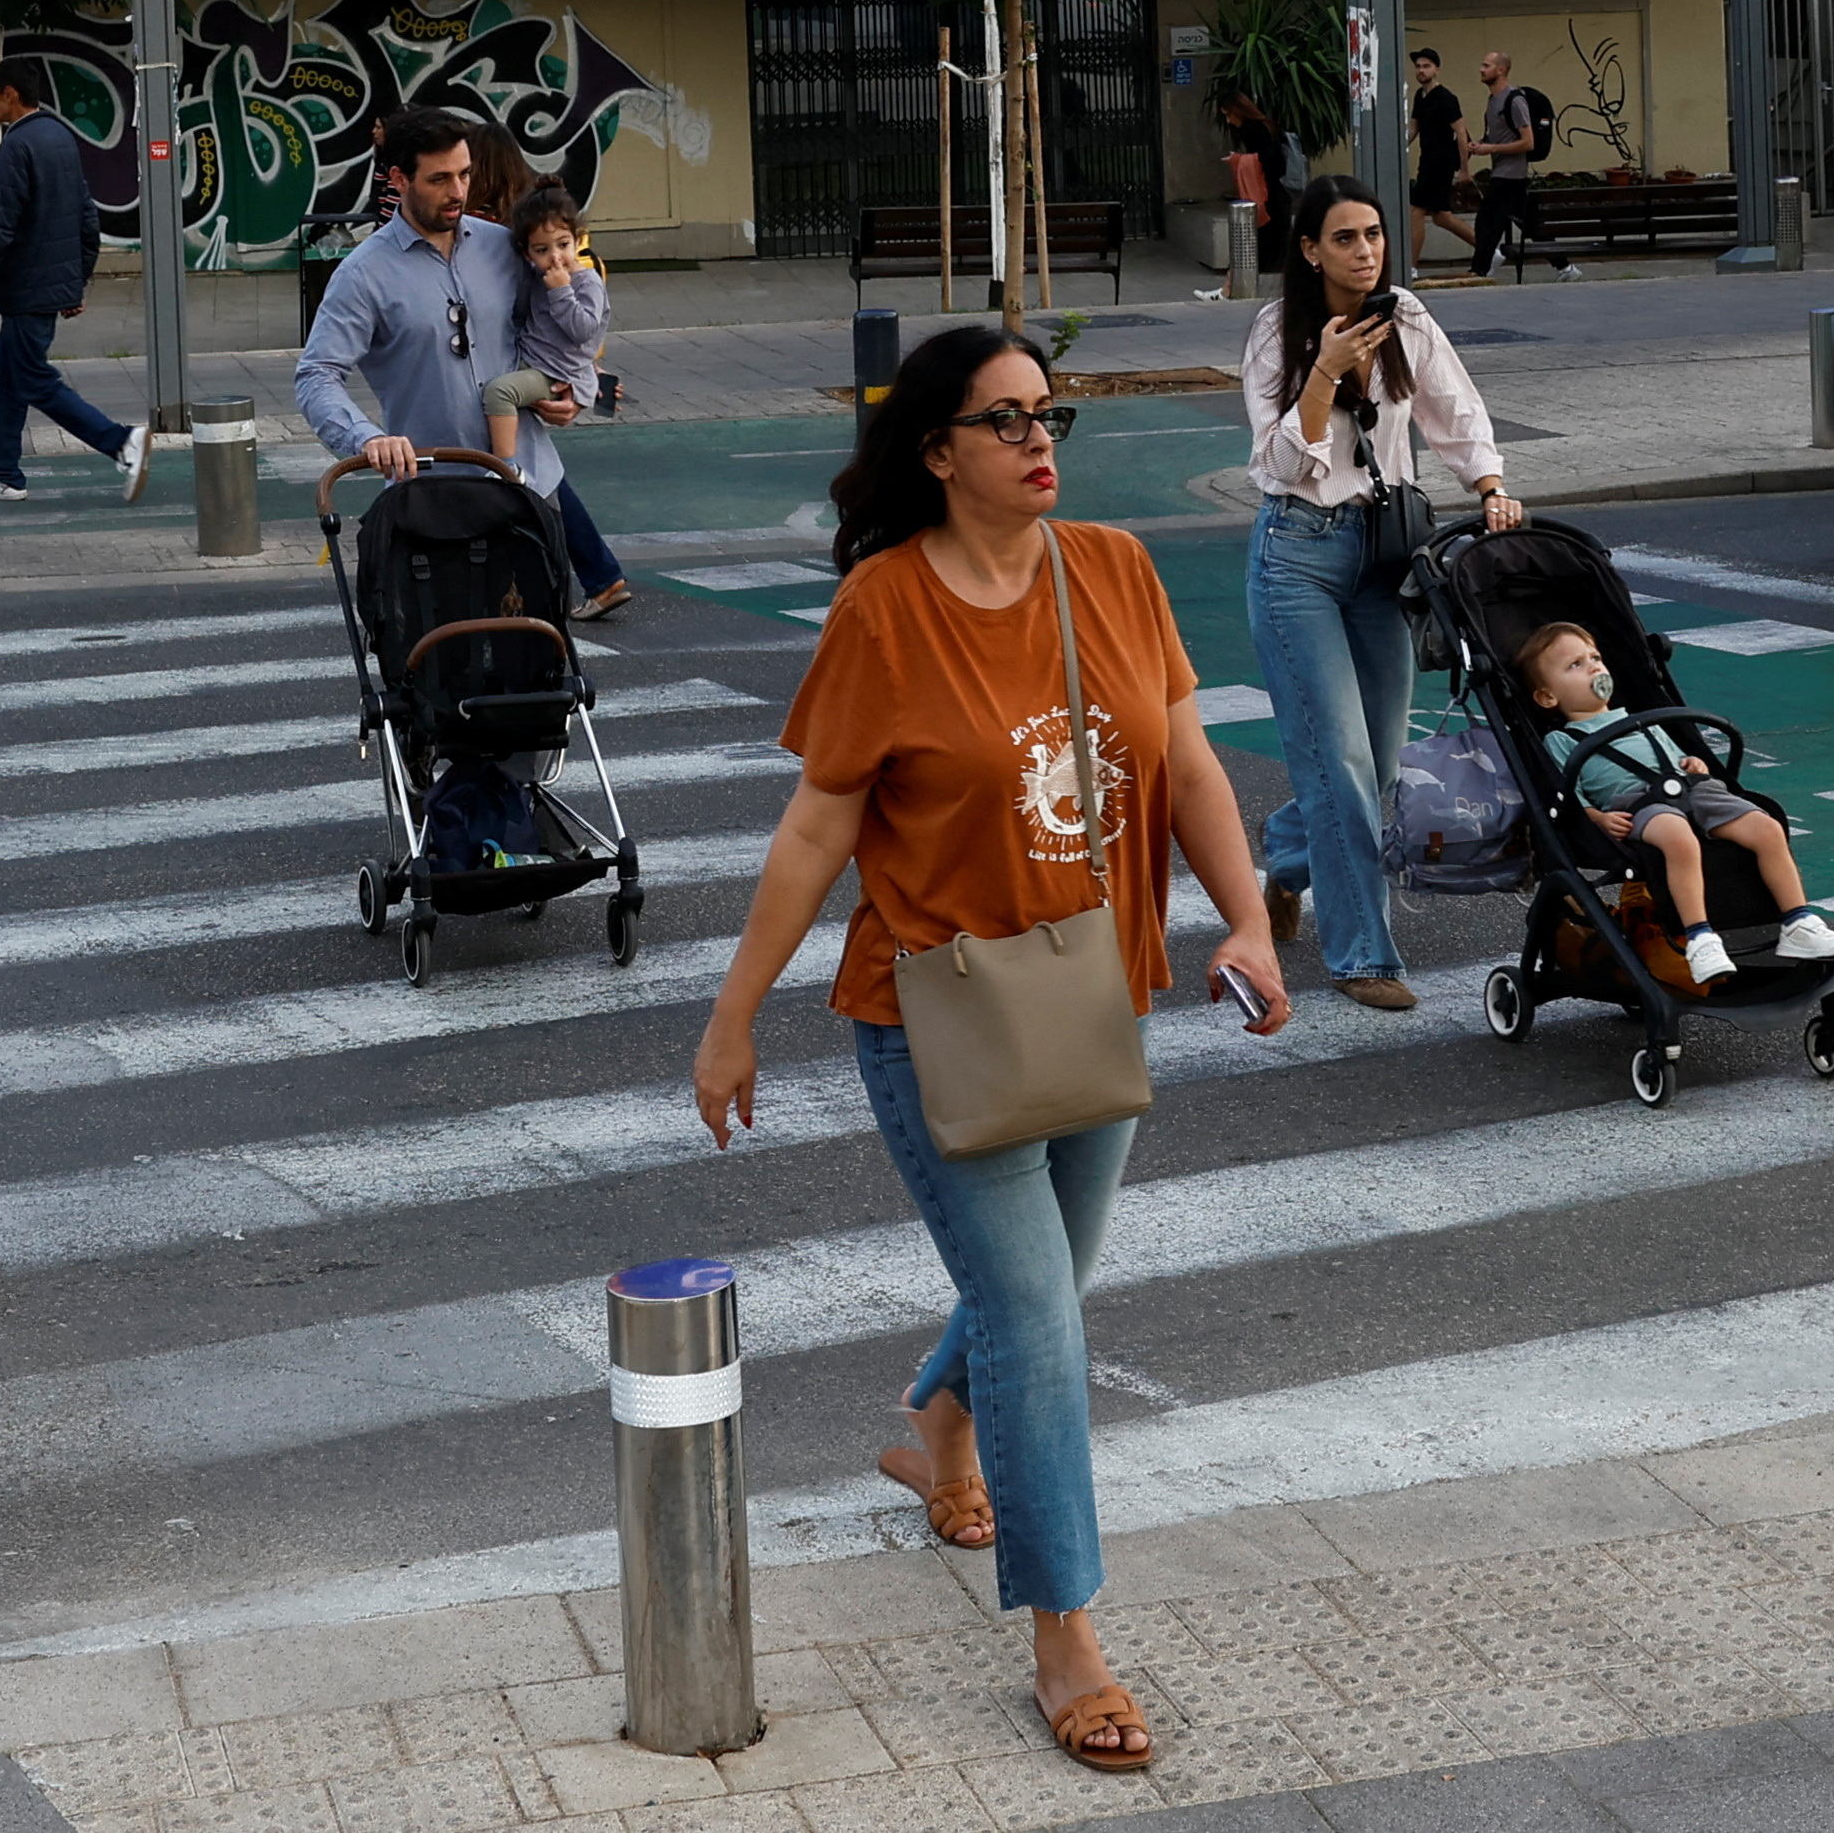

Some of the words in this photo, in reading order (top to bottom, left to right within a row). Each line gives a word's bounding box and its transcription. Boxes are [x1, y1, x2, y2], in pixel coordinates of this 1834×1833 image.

[1177, 34, 1203, 44] כניסה
[1087, 704, 1112, 723] Day
[1028, 848, 1046, 861] Life
[1049, 851, 1057, 862] is
